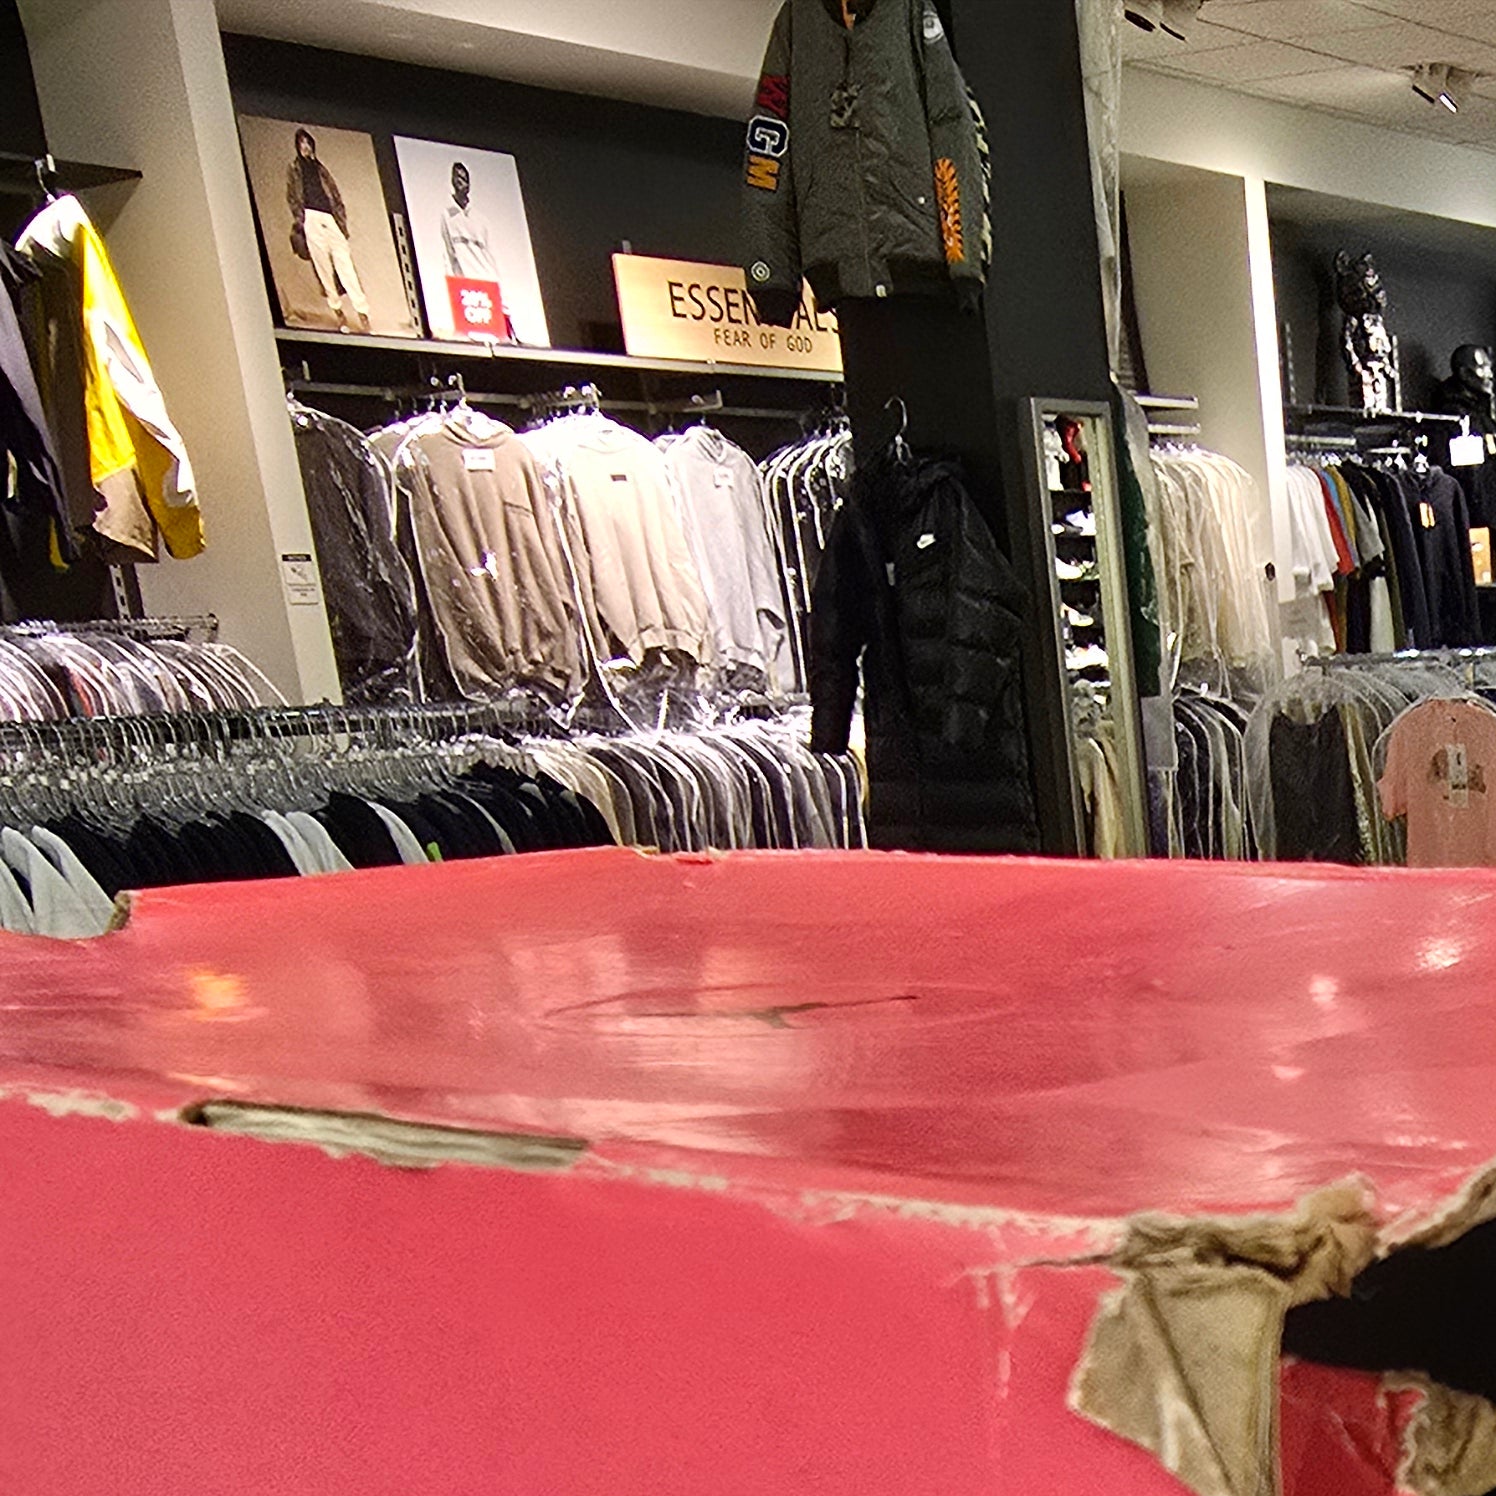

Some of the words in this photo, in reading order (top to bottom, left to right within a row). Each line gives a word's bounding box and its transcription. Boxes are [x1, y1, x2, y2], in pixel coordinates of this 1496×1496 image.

[714, 328, 751, 348] FEAR
[760, 334, 776, 349] OF
[787, 335, 813, 353] GOD
